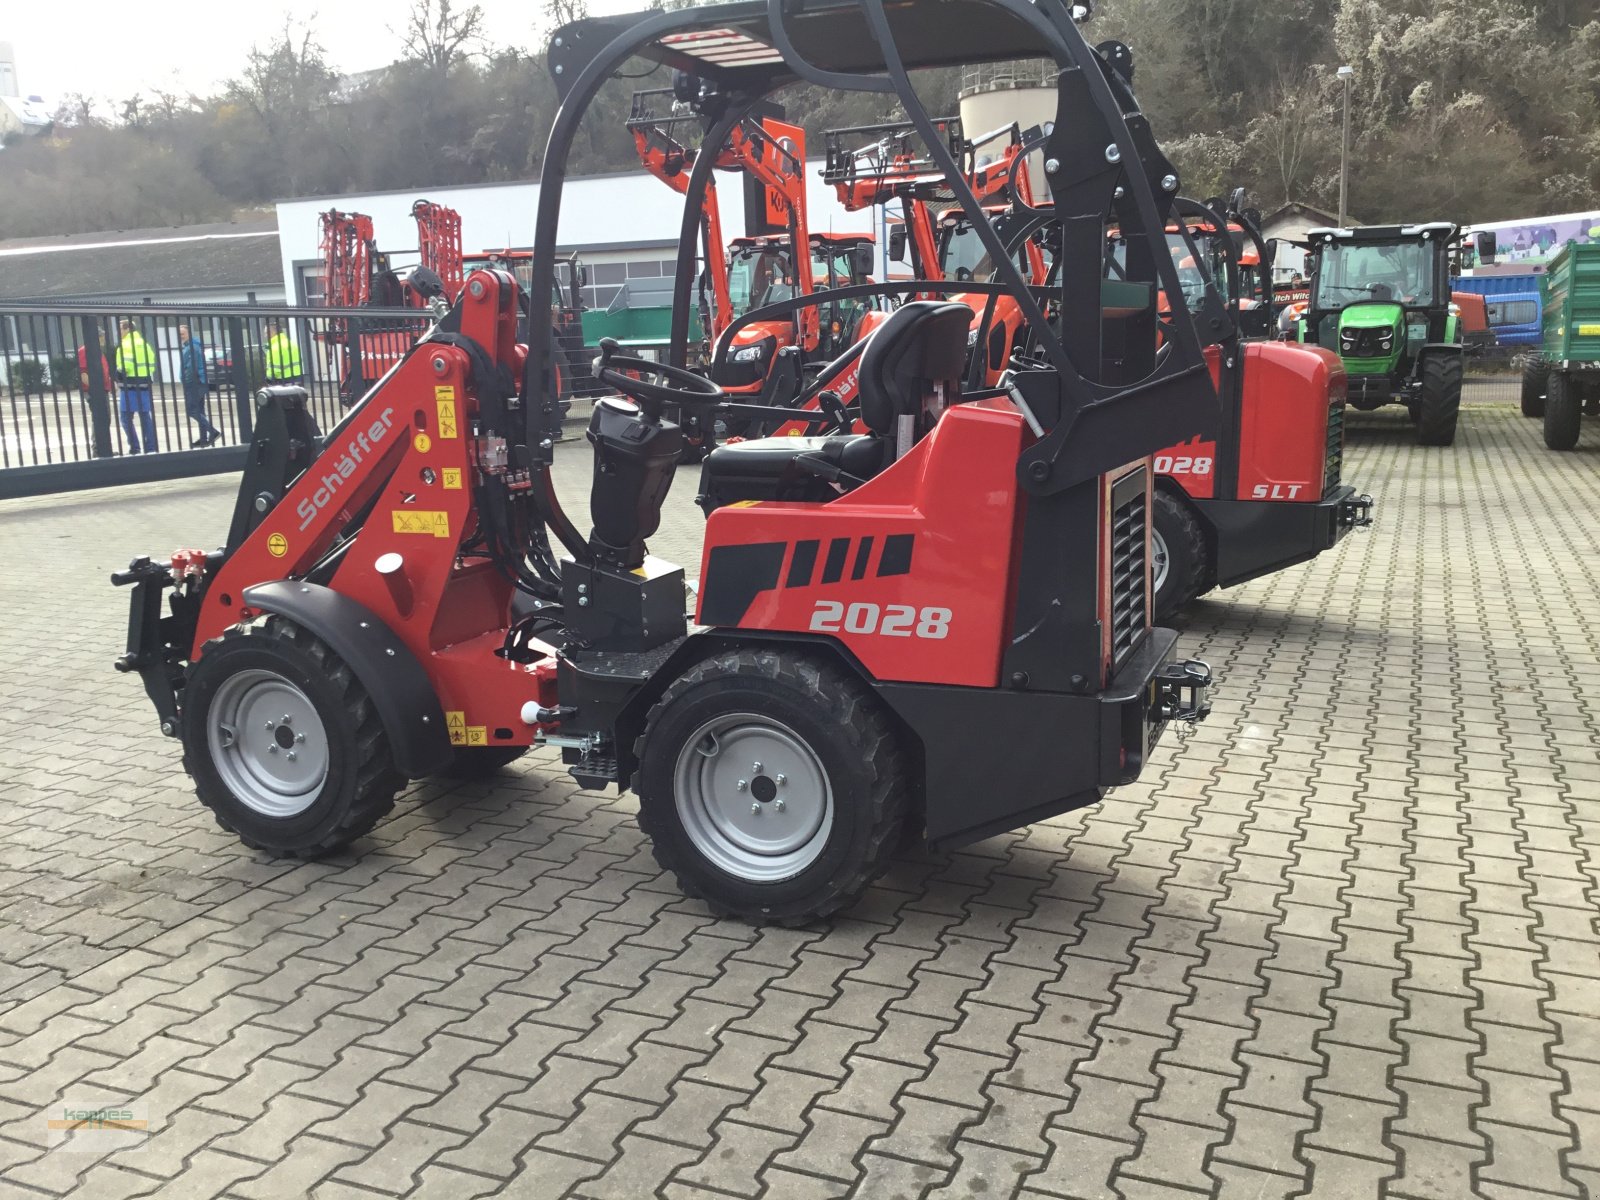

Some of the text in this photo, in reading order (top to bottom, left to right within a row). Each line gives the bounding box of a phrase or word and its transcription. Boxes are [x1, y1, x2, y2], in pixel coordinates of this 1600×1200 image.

[1274, 292, 1310, 302] itch Witc
[296, 407, 394, 532] Schäffer
[1153, 456, 1213, 475] 028
[1251, 484, 1302, 499] SLT
[808, 600, 953, 640] 2028
